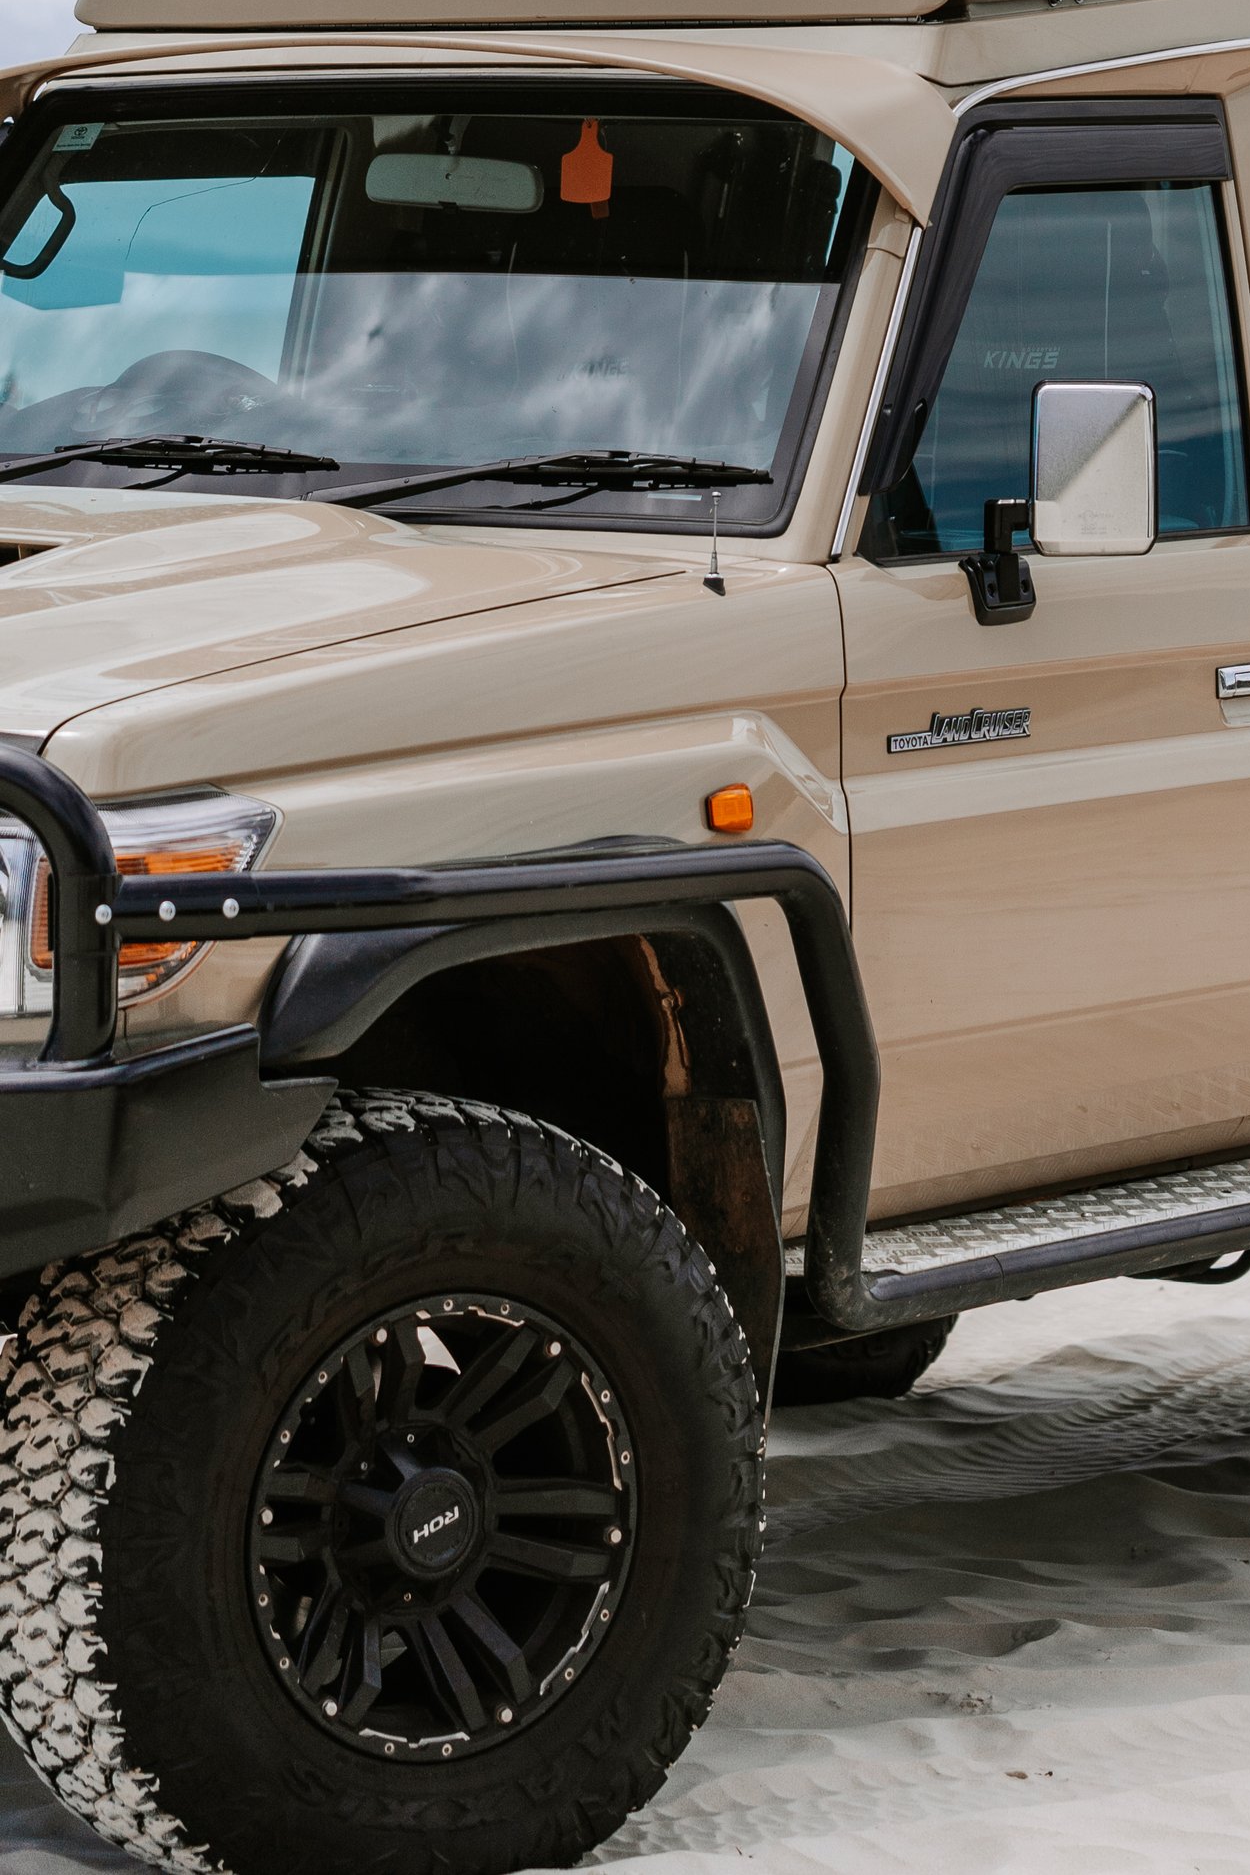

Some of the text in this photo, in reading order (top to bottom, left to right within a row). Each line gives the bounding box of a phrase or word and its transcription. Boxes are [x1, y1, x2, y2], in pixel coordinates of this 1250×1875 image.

[983, 350, 1060, 369] KINGS
[892, 736, 929, 750] TOYOTA
[412, 1504, 460, 1545] ROH
